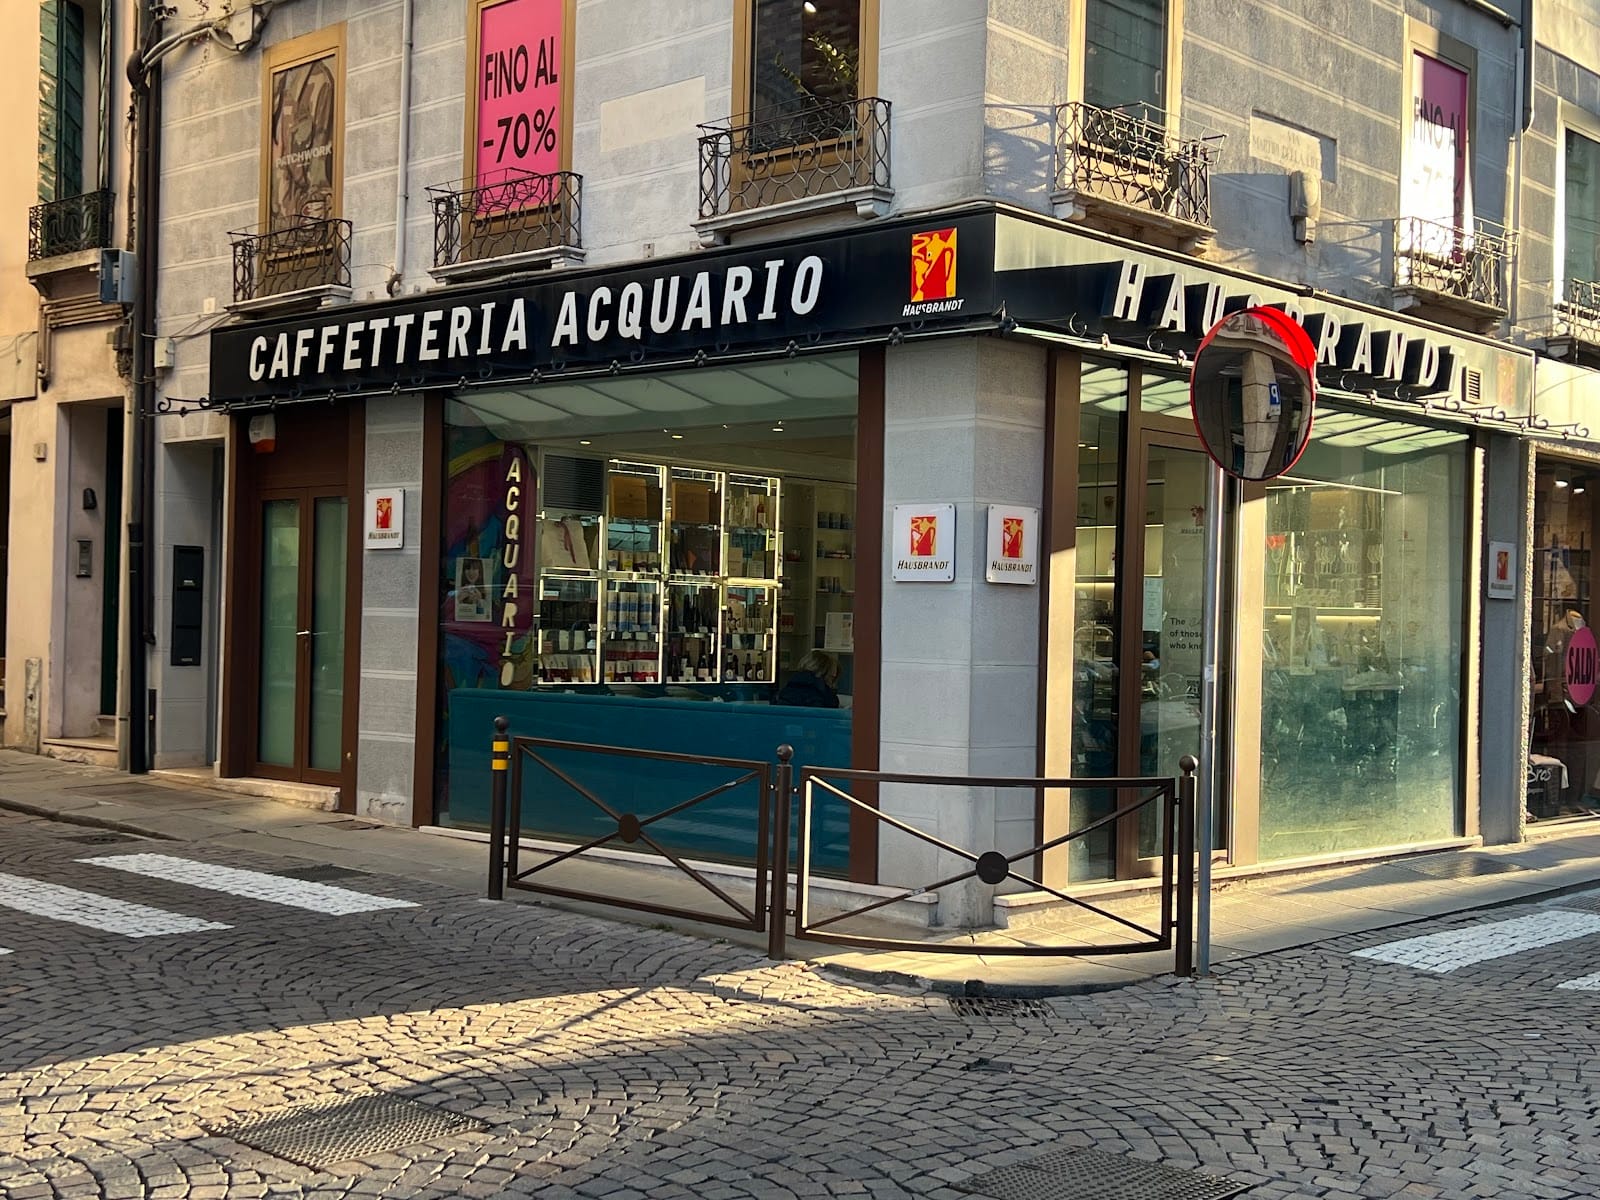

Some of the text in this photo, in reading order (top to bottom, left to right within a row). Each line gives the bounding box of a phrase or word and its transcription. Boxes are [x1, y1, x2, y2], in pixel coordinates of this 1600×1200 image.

[485, 36, 558, 101] FINO AL
[483, 106, 556, 163] -70%
[1413, 95, 1463, 158] FINO AL
[276, 141, 332, 168] PATCHWORK
[249, 255, 823, 381] CAFFETTERIA ACQUARIO
[902, 299, 965, 317] HAUSBRANDT
[1113, 259, 1466, 393] HAURANDT
[501, 457, 521, 686] ACQUARIO
[897, 559, 949, 570] HAUSBRANDT
[991, 560, 1033, 573] HAUSBRANDT
[1169, 629, 1179, 638] of
[1568, 646, 1596, 685] SALDI
